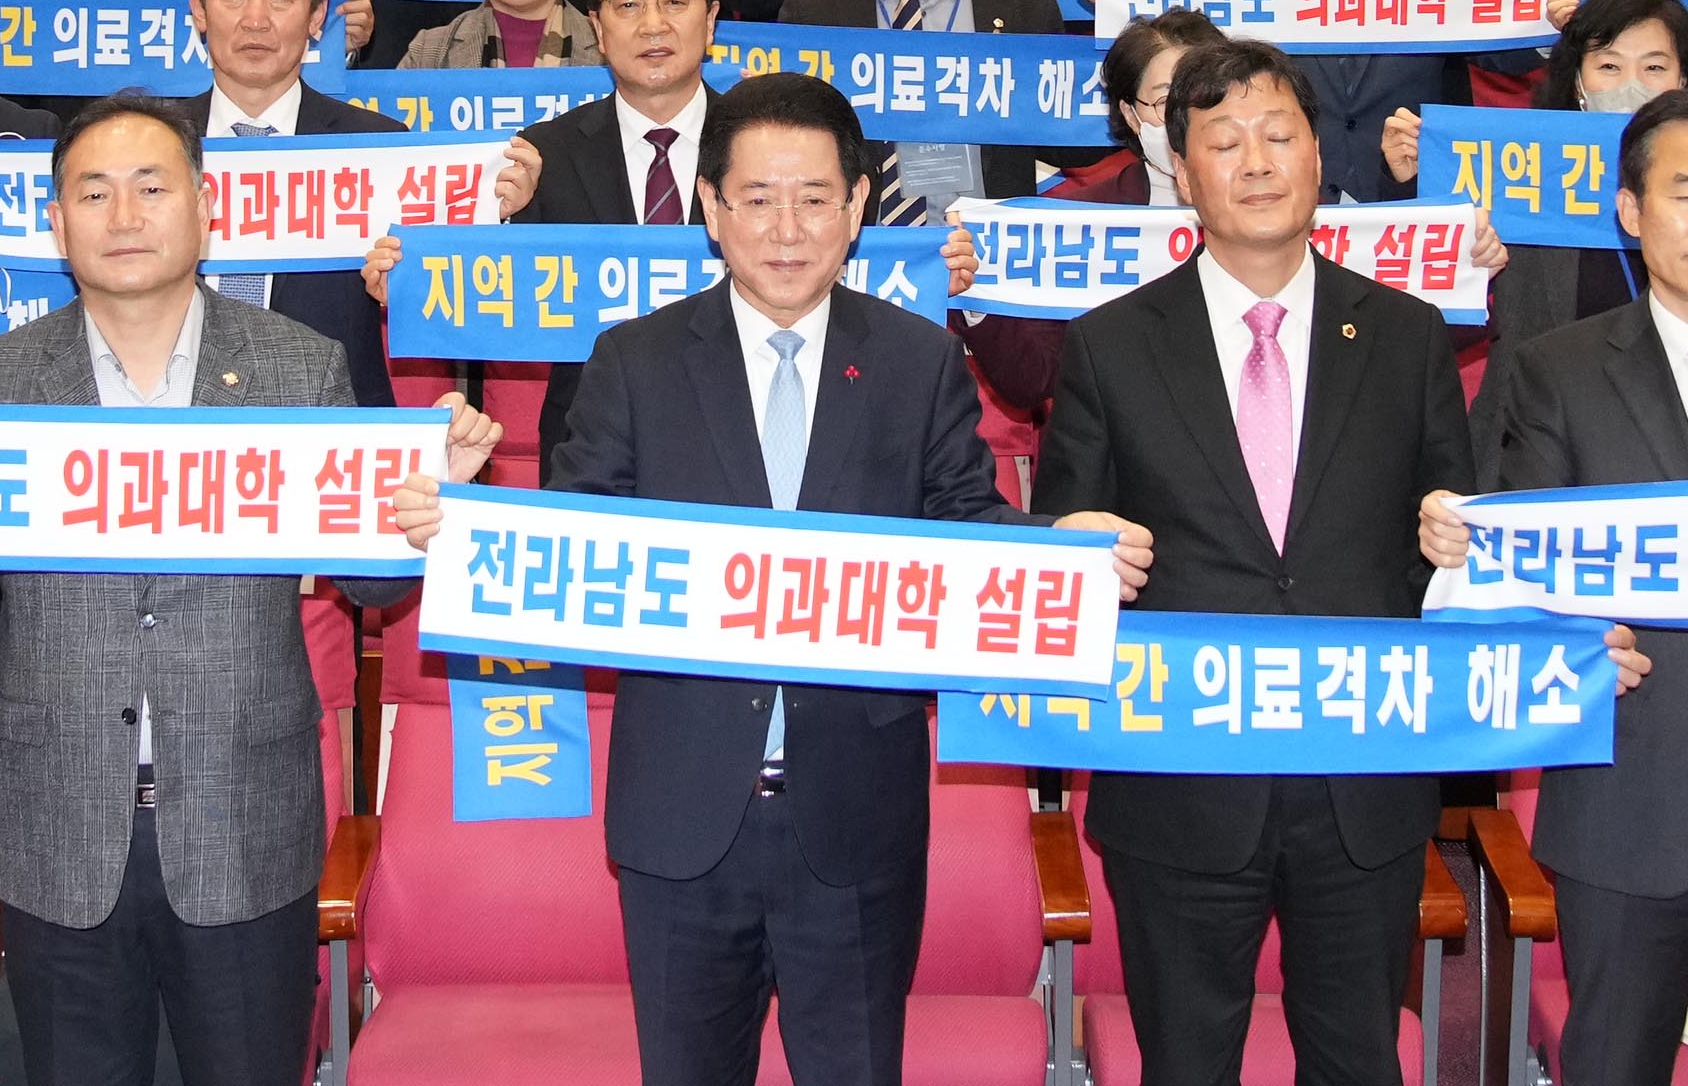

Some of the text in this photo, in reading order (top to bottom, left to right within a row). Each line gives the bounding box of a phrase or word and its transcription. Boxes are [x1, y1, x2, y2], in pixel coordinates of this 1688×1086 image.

[0, 12, 34, 66] 간
[850, 53, 1015, 118] 의료격차
[398, 163, 480, 226] 설립
[1452, 141, 1605, 215] 지역 간
[970, 221, 1140, 290] 전라남도
[1373, 221, 1463, 290] 설립
[421, 256, 578, 327] 지역 간
[62, 446, 285, 536] 의과대학
[468, 529, 1083, 657] 전라남도 의과대학 설립
[1468, 525, 1679, 596] 전라남도
[1115, 645, 1168, 733] 간
[1193, 645, 1432, 734] 의료격차
[1467, 640, 1580, 727] 해소
[481, 694, 558, 786] 지역
